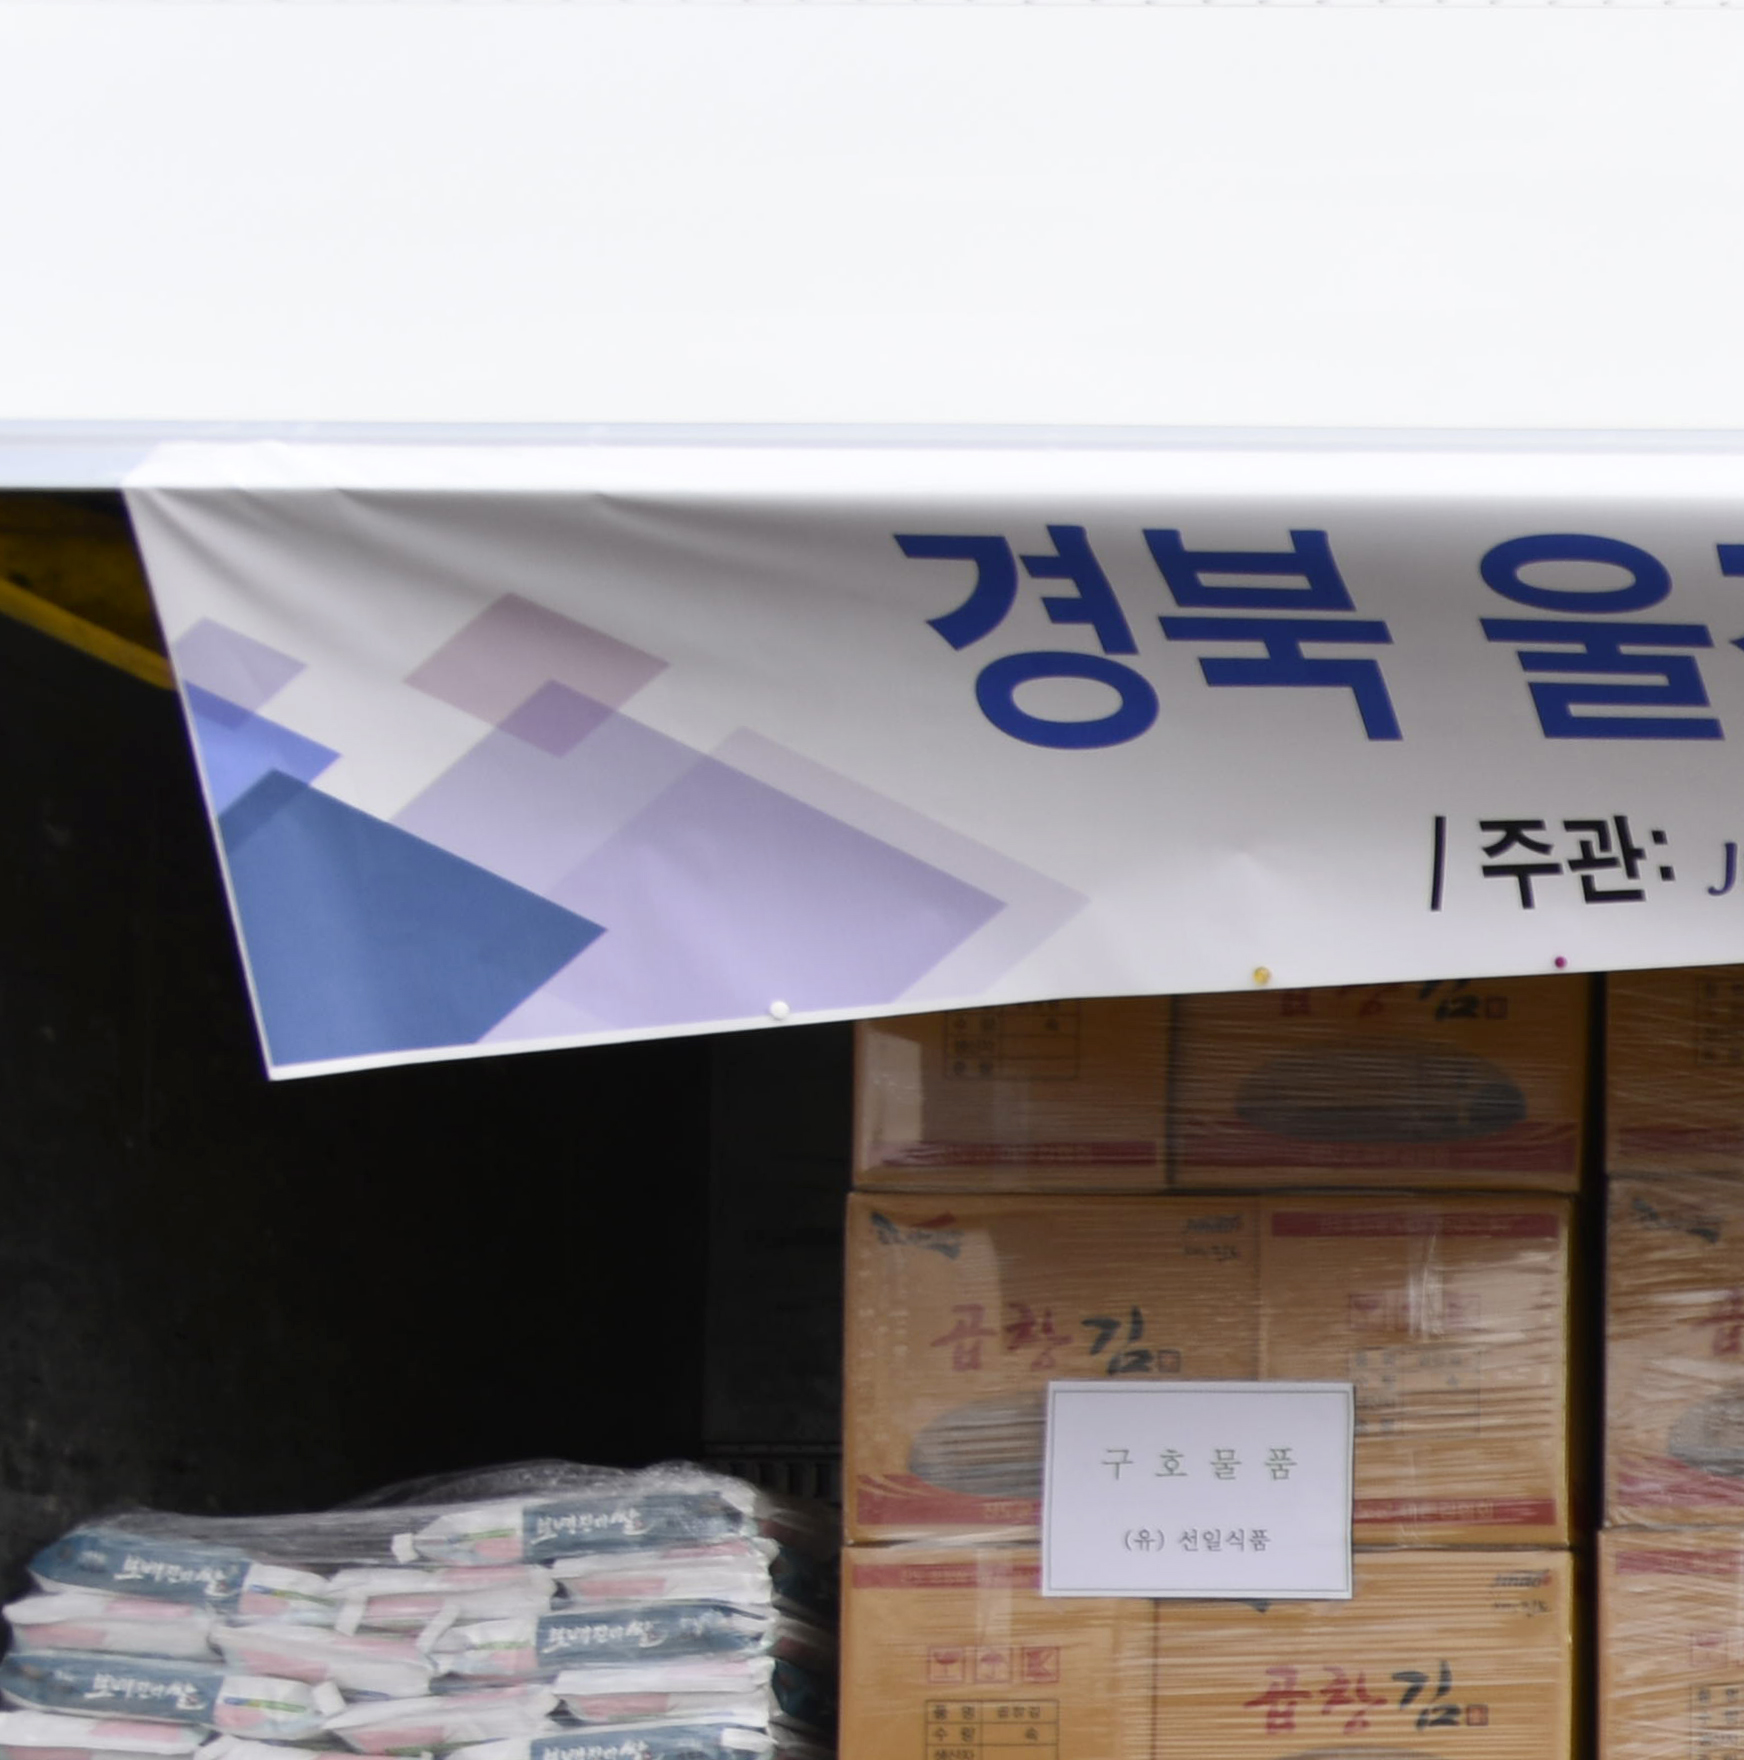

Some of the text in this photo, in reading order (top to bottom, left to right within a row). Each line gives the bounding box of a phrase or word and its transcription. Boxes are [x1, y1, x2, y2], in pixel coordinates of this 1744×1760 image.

[893, 522, 1402, 750] 경북
[1479, 815, 1676, 908] 주관:
[1124, 1527, 1271, 1553] (유) 선일식품
